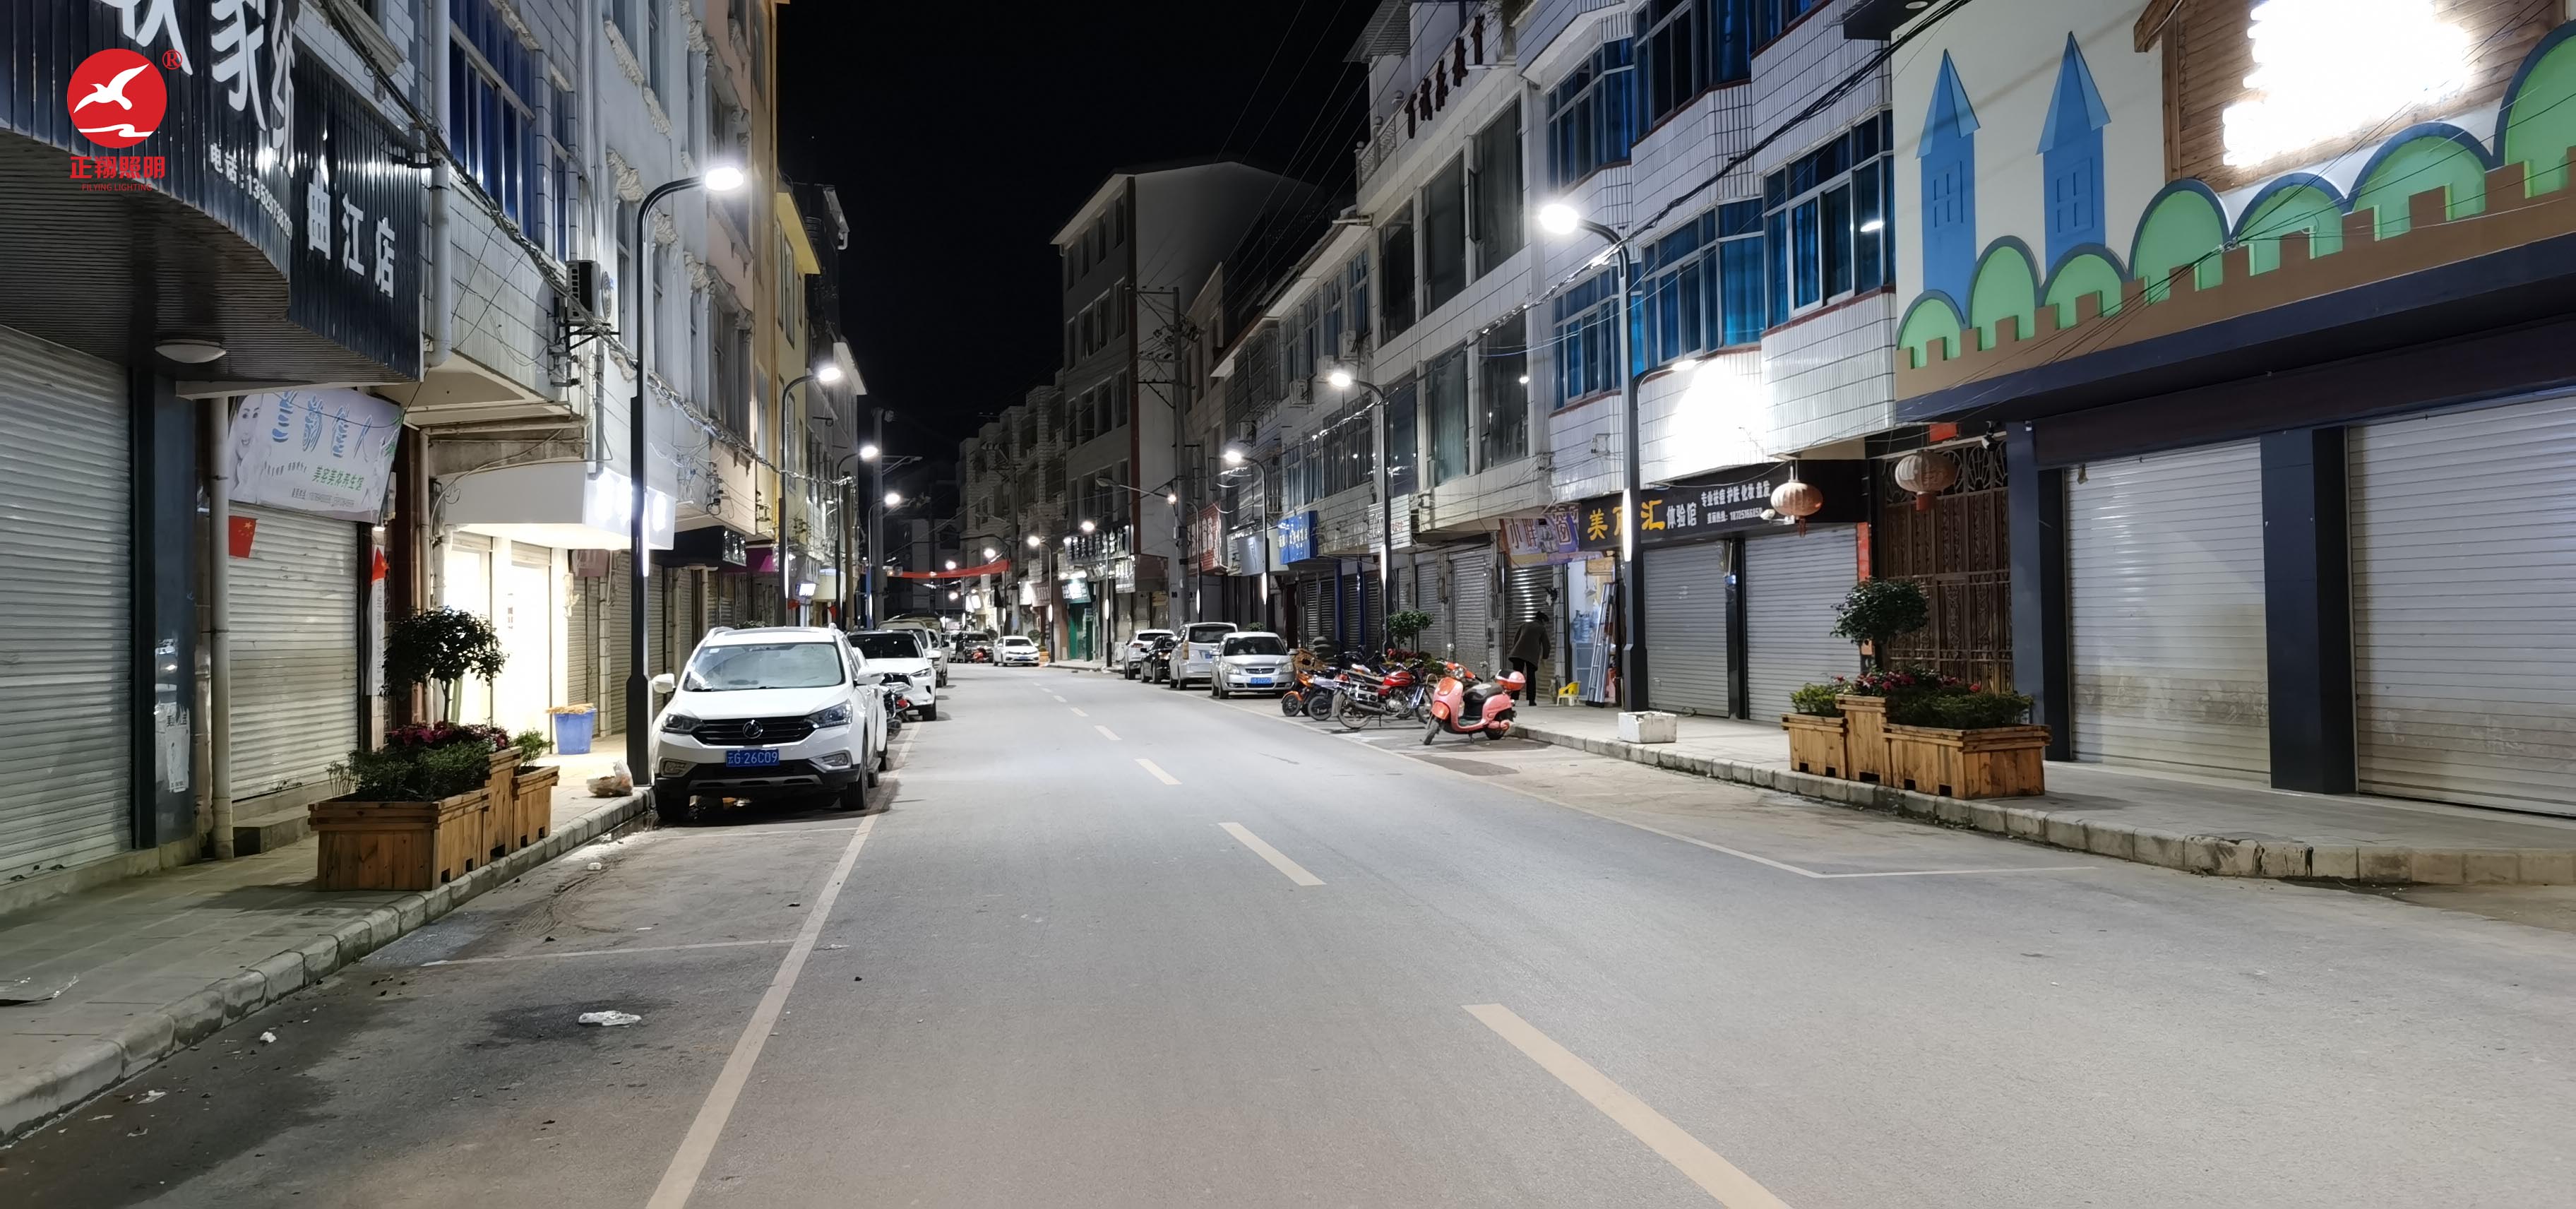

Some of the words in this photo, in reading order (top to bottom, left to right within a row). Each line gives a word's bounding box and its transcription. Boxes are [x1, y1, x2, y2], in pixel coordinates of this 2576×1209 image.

[308, 169, 395, 298] 曲江店
[1666, 502, 1697, 529] 体验馆
